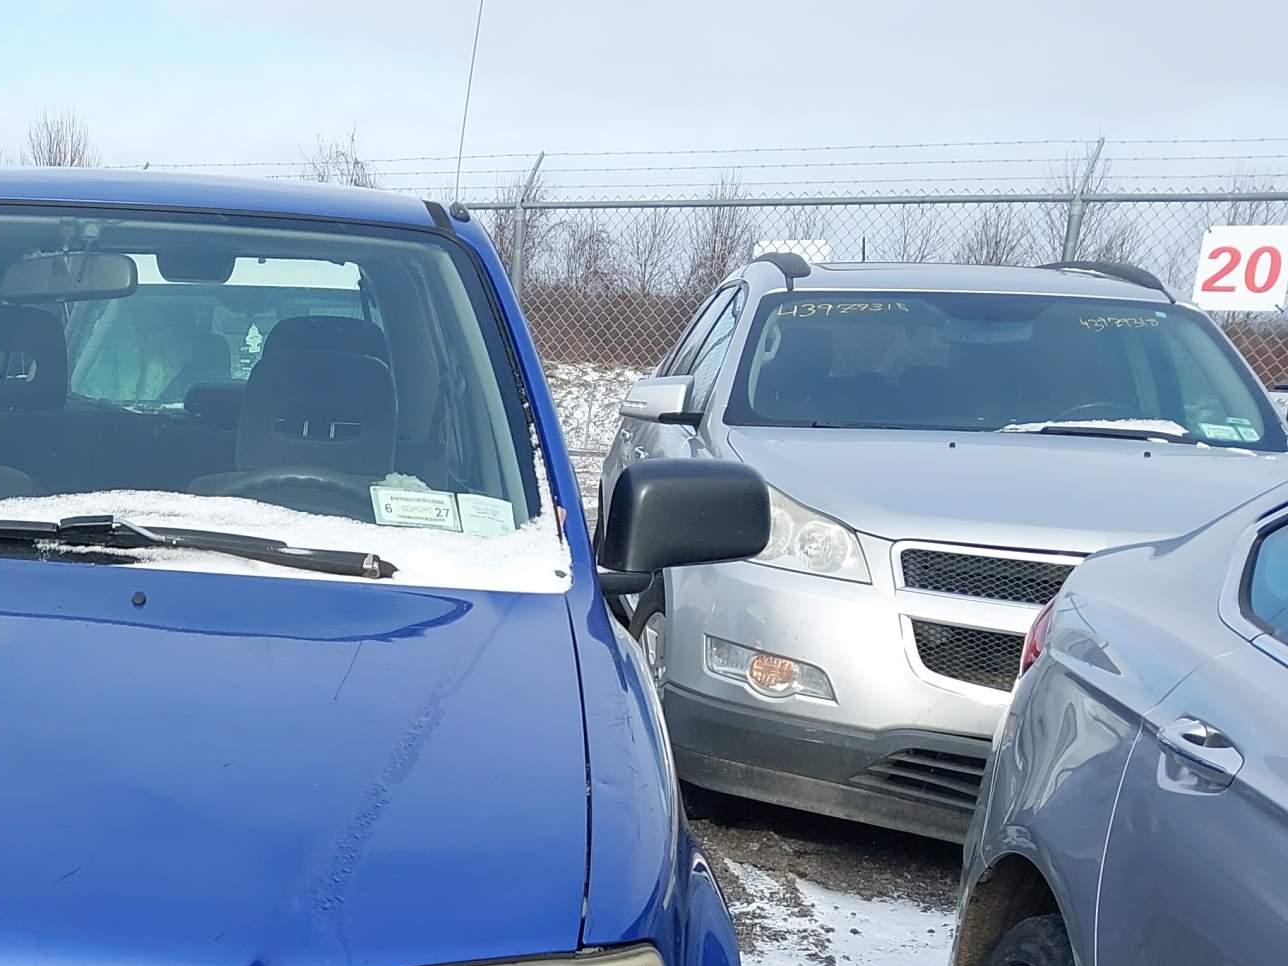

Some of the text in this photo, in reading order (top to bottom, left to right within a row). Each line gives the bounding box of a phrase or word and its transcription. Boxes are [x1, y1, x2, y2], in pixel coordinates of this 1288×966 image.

[1201, 246, 1282, 293] 20
[384, 503, 393, 514] 6
[434, 507, 450, 518] 27
